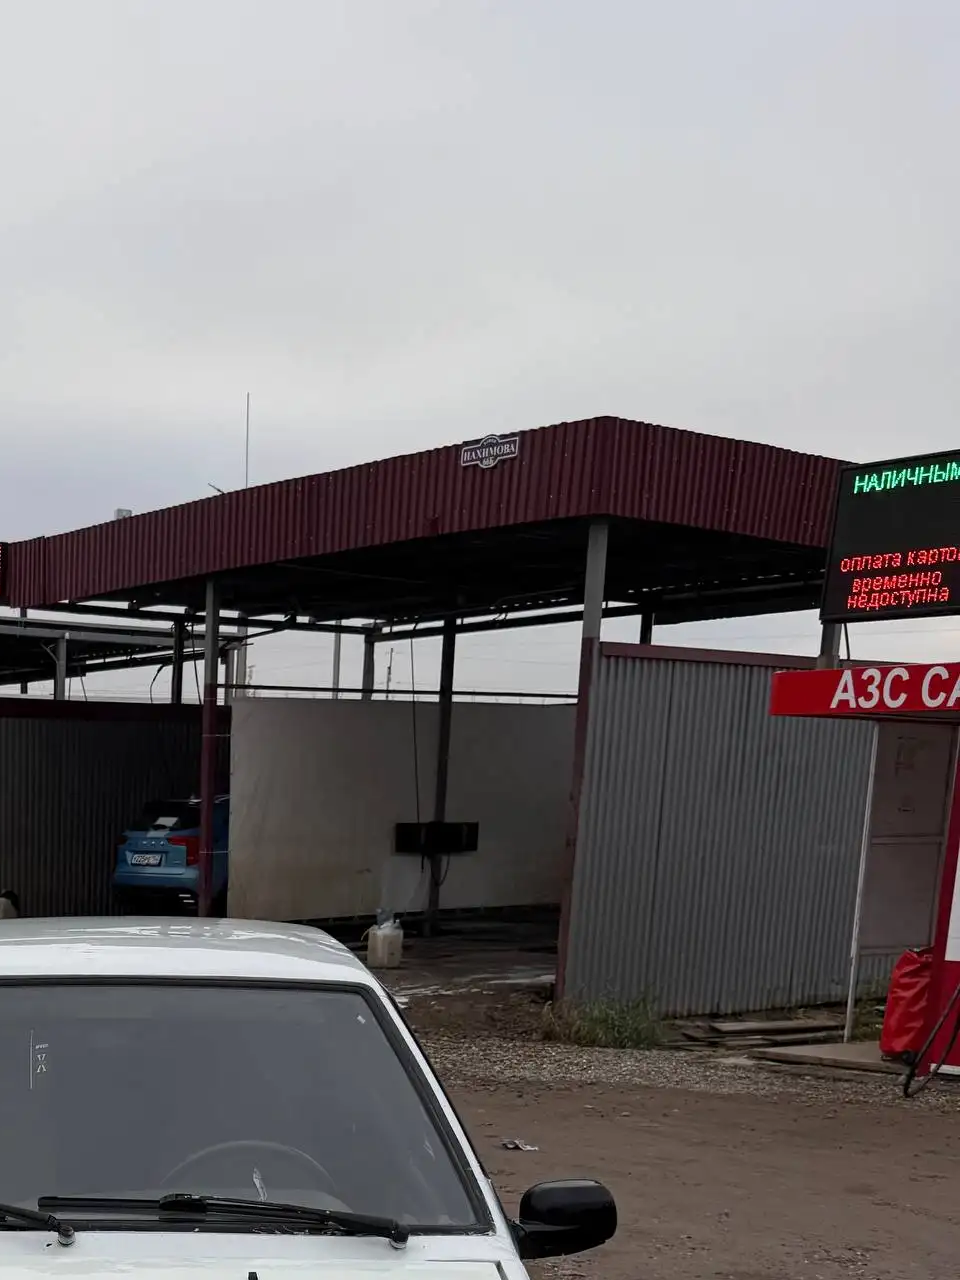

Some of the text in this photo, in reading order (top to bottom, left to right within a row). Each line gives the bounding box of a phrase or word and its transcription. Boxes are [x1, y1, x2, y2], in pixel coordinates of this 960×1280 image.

[840, 547, 960, 572] оплата карто
[852, 571, 942, 594] временно
[847, 587, 949, 611] недоступна
[829, 667, 910, 709] АЗС
